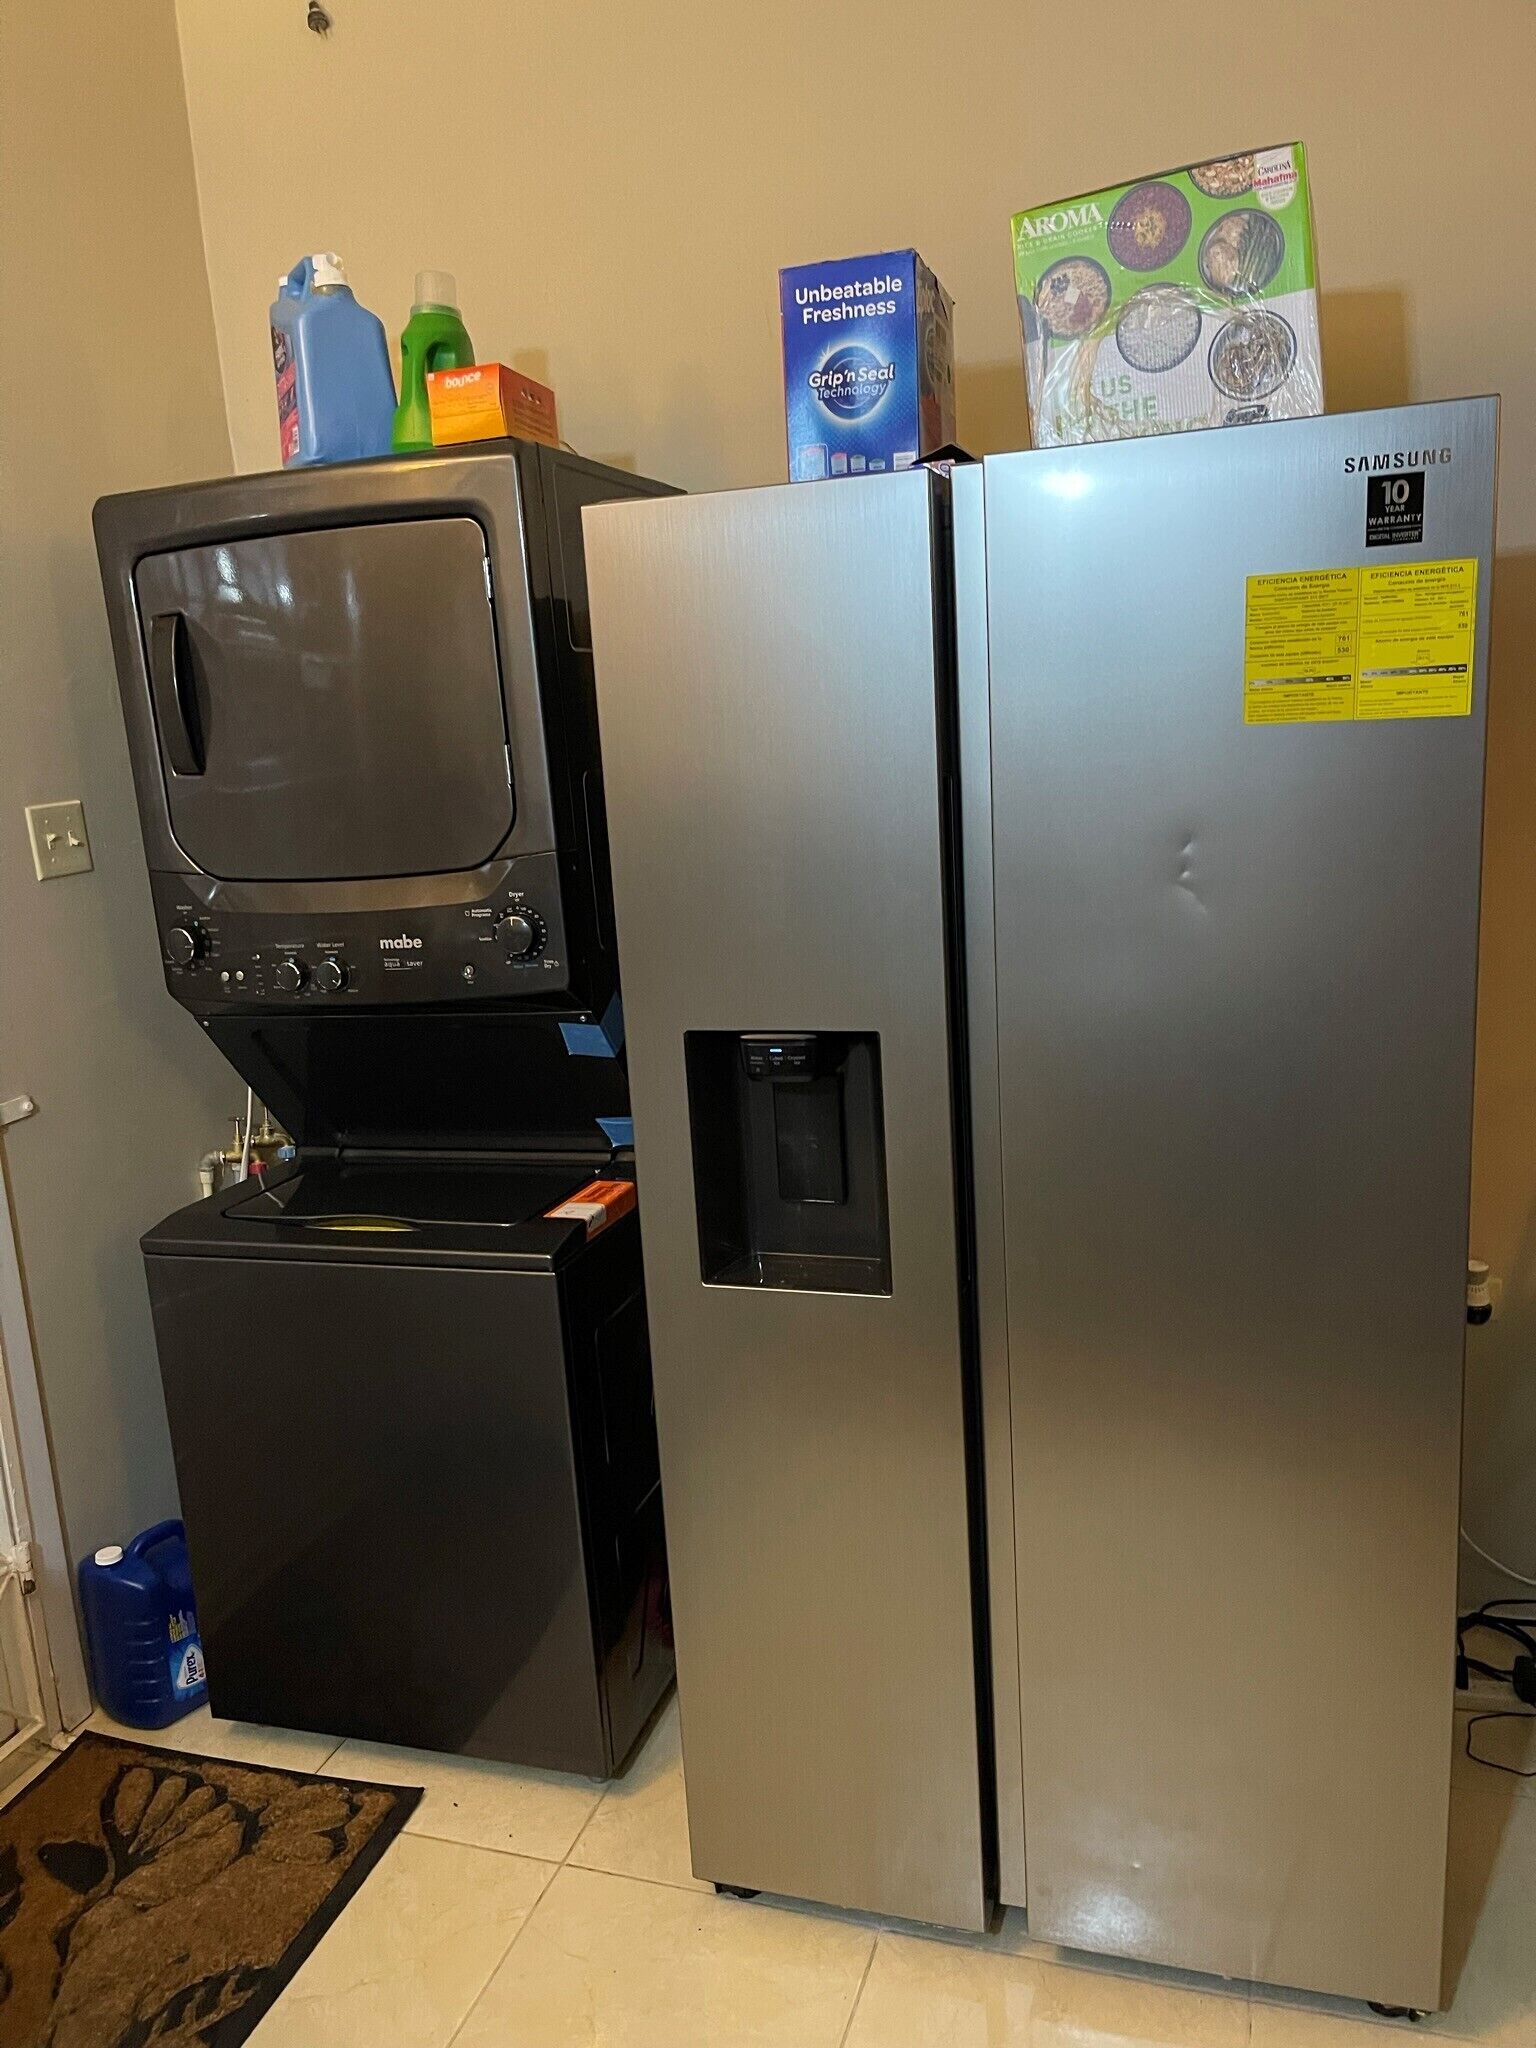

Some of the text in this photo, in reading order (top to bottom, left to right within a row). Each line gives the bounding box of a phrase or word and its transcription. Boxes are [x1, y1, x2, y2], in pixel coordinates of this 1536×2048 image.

[1017, 203, 1103, 242] AROMA
[795, 275, 902, 304] Unbeatable
[803, 300, 896, 324] Freshness
[445, 371, 481, 389] bounce
[858, 363, 894, 381] Seal
[818, 382, 887, 399] Technology
[1344, 447, 1452, 473] SAMSUNG
[1381, 479, 1410, 505] 10
[1385, 504, 1405, 513] YEAR
[1368, 513, 1422, 526] WARRANTY
[1257, 577, 1298, 586] EFICIENCIA
[1370, 571, 1413, 579] EFICIENCIA
[508, 891, 524, 899] Dryer
[379, 933, 423, 949] mabe
